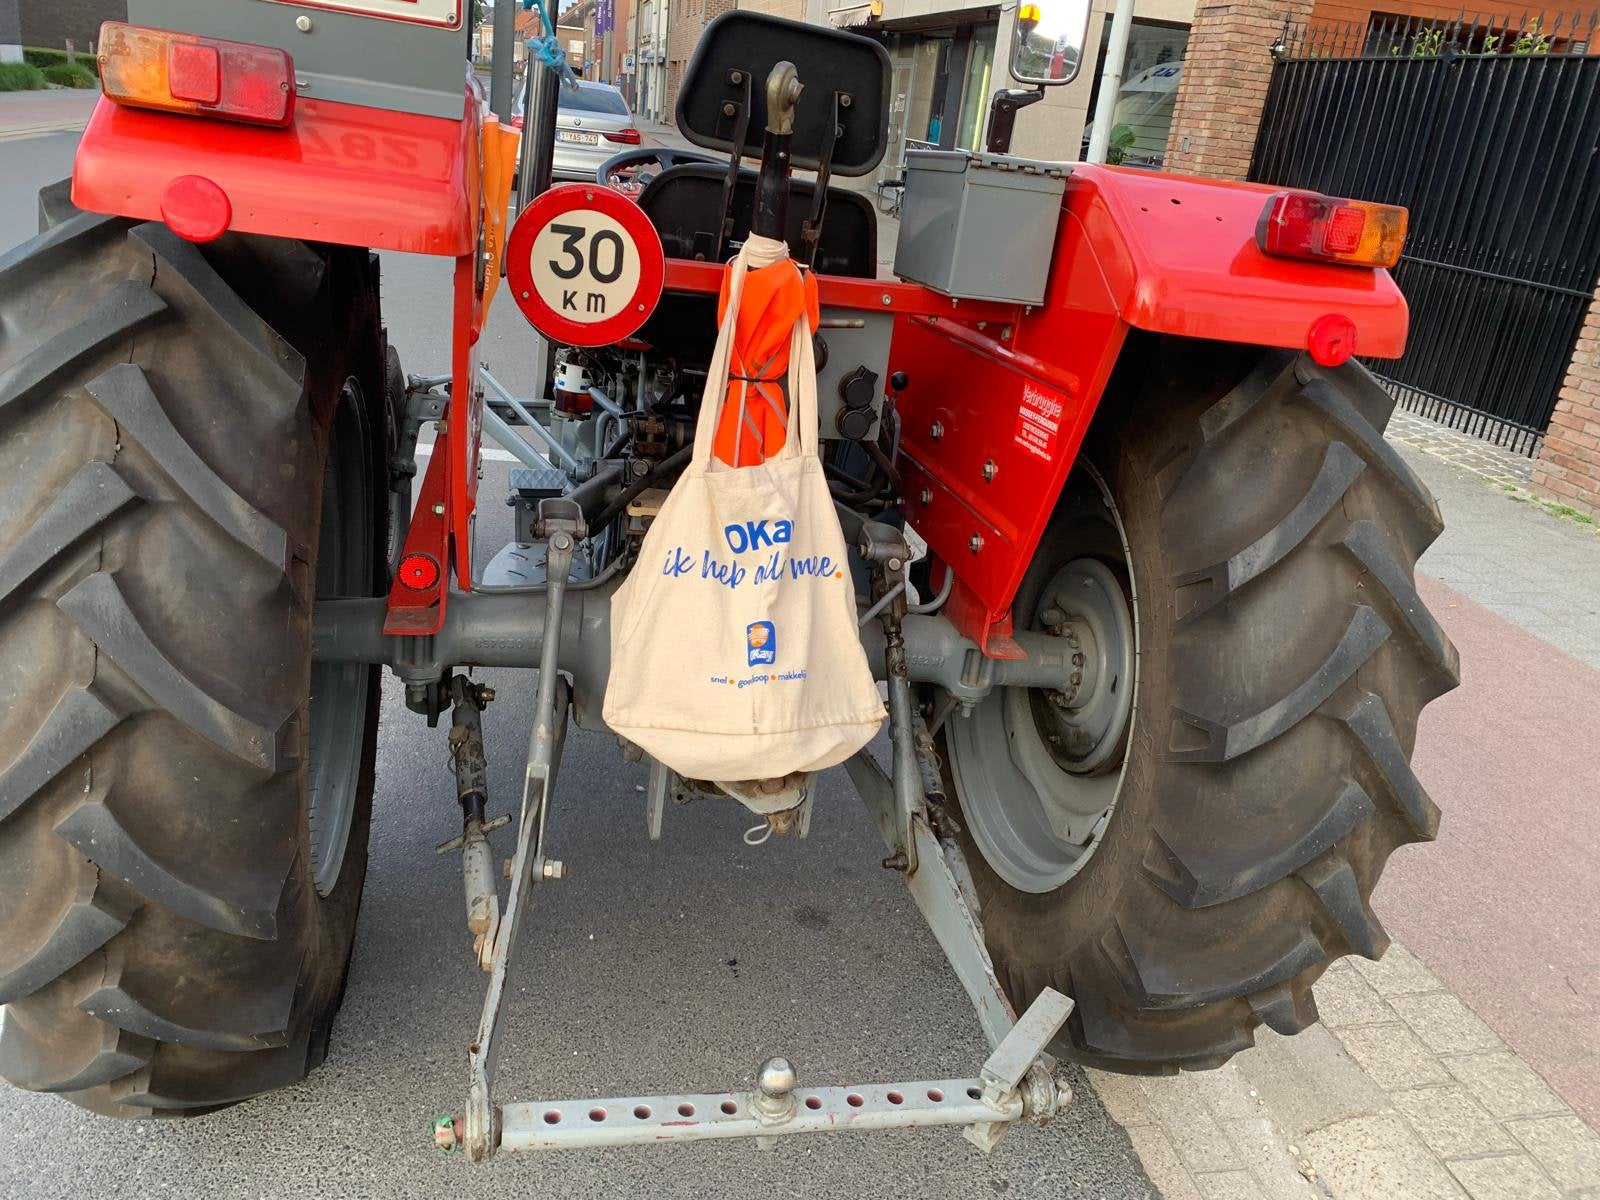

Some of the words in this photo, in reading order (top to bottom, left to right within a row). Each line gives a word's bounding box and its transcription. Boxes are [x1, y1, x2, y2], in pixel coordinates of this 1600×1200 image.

[549, 223, 624, 284] 30
[724, 519, 795, 554] OKa
[662, 547, 697, 578] ik
[701, 550, 746, 588] heb
[710, 675, 728, 684] snel
